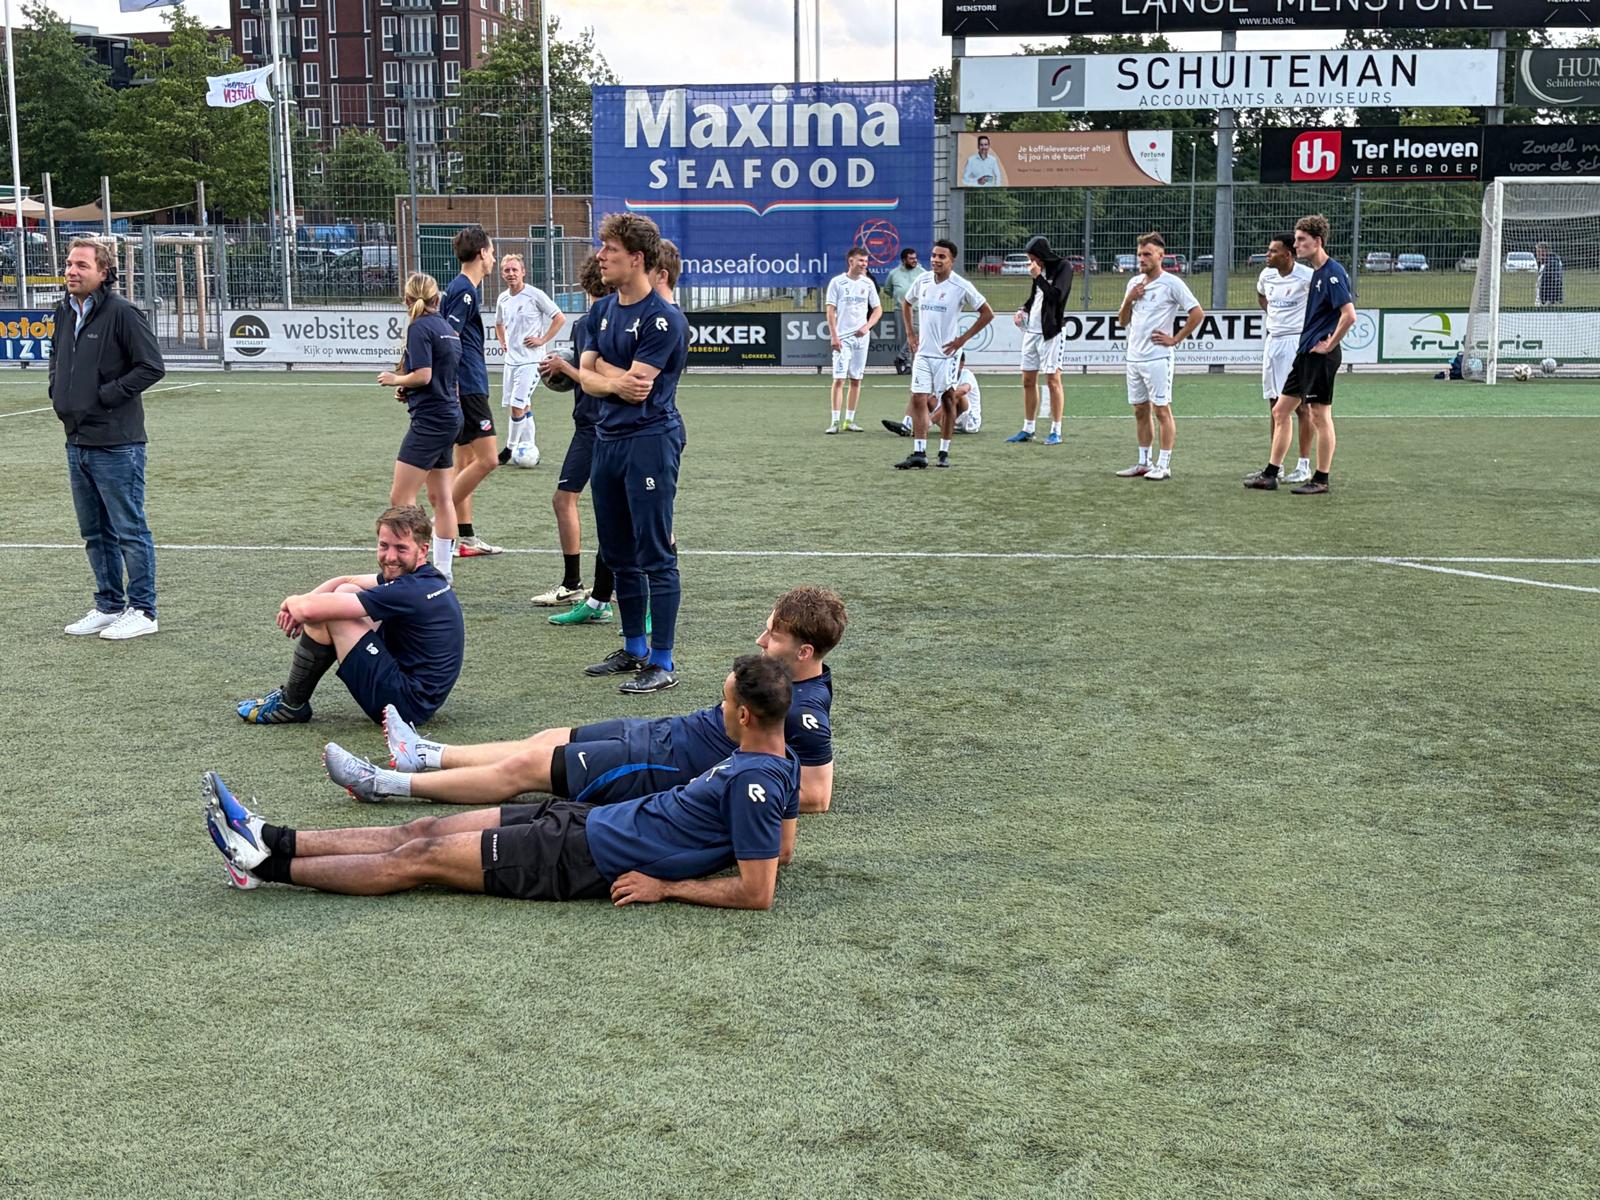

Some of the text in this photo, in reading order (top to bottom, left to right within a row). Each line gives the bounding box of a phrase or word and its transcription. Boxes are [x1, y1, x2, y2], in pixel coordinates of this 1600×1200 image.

[1239, 17, 1296, 25] WWW.DLNG.NL
[1117, 54, 1417, 90] SCHUITEMAN
[1139, 92, 1392, 107] ACCOUNTANTS & ADVISEURS
[624, 85, 901, 149] Maxima
[1018, 144, 1111, 154] Je koffieleverancier altijd
[1352, 138, 1478, 160] Ter Hoeven
[1522, 137, 1577, 154] Zoveel
[1018, 153, 1028, 163] bij
[1029, 154, 1041, 163] jou
[1052, 153, 1062, 161] de
[1063, 153, 1086, 161] buurt!
[1297, 137, 1335, 173] th
[1509, 162, 1546, 172] voor
[1550, 153, 1572, 171] de
[648, 157, 876, 190] SEAFOOD
[1352, 163, 1478, 175] VERFGROEP
[282, 316, 404, 339] websites &
[303, 345, 321, 357] Kijk
[322, 347, 334, 357] op
